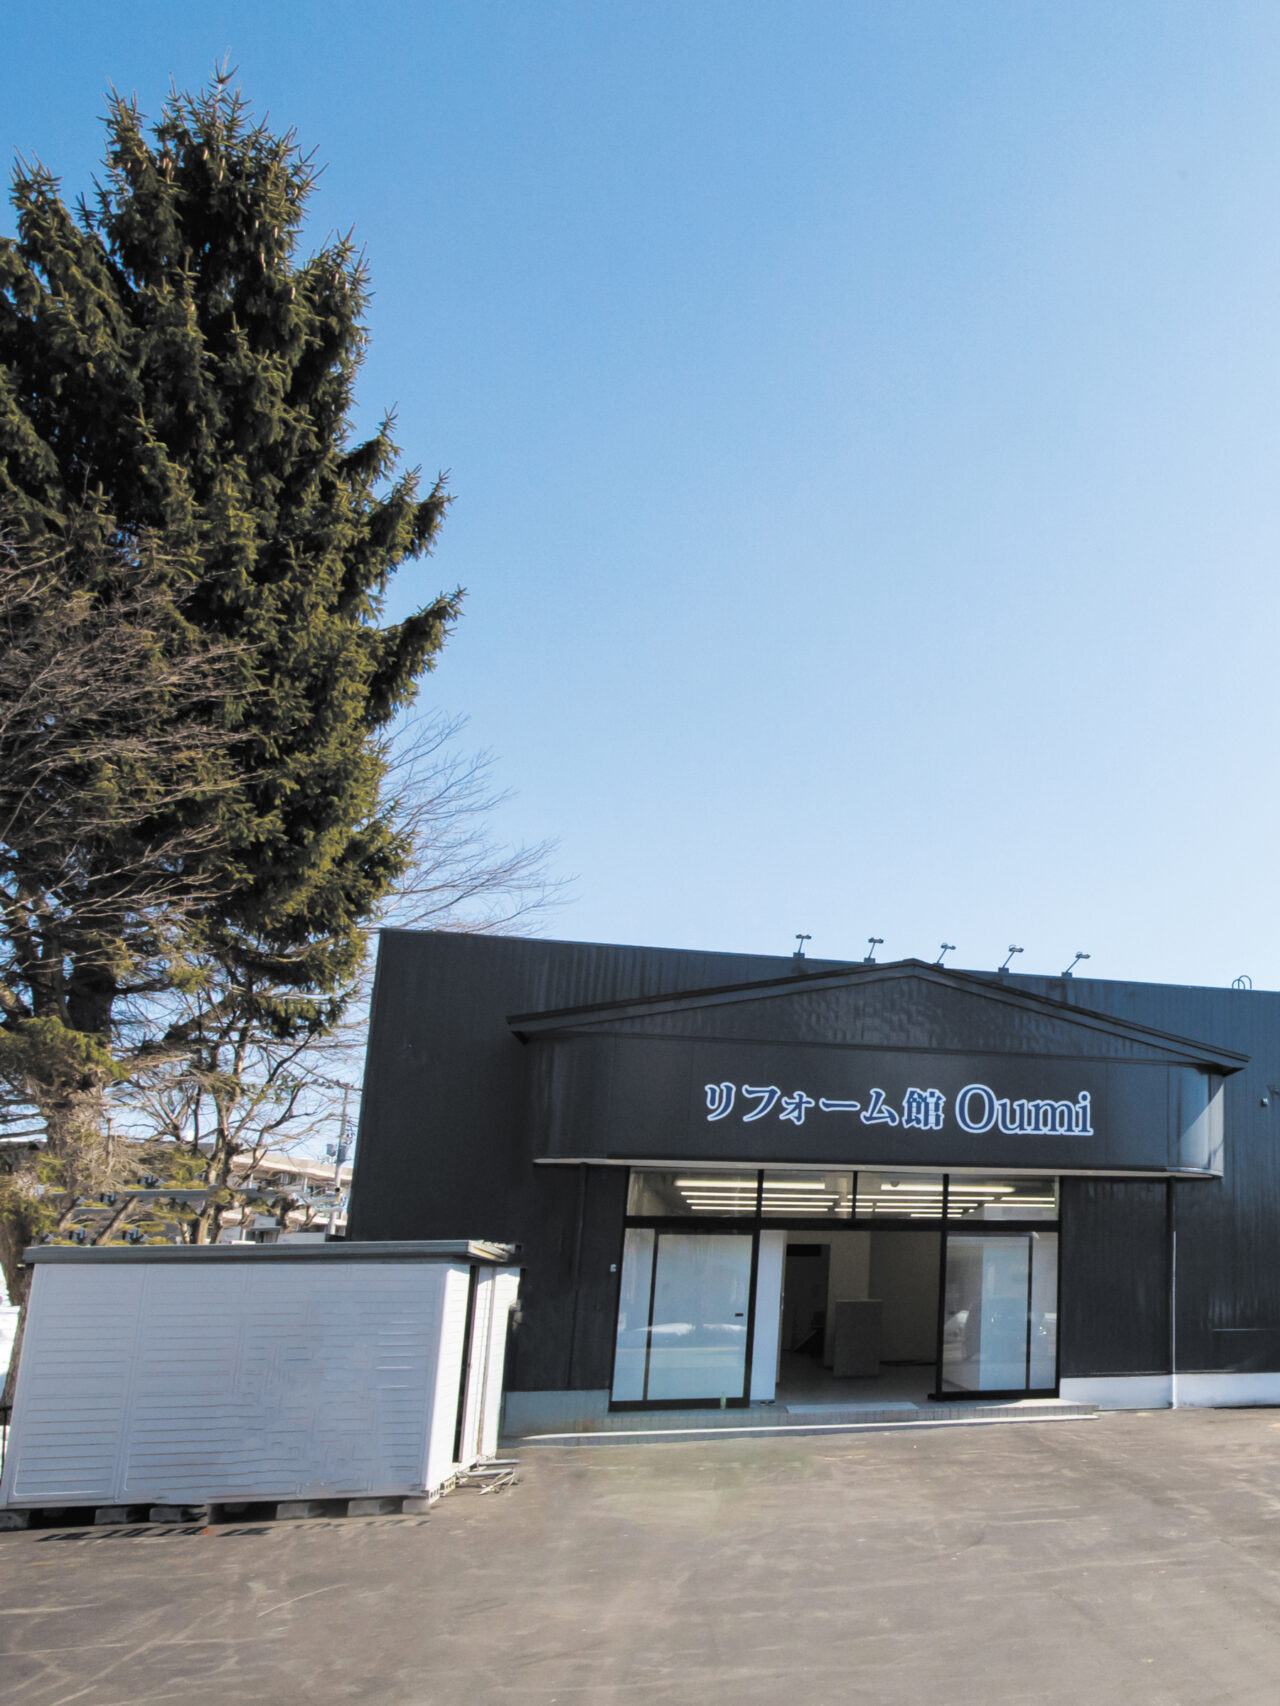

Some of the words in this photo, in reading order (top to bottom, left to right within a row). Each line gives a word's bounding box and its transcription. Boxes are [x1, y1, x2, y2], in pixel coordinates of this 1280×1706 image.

[704, 1082, 946, 1130] リフォーム館
[955, 1083, 1094, 1136] Oumi
